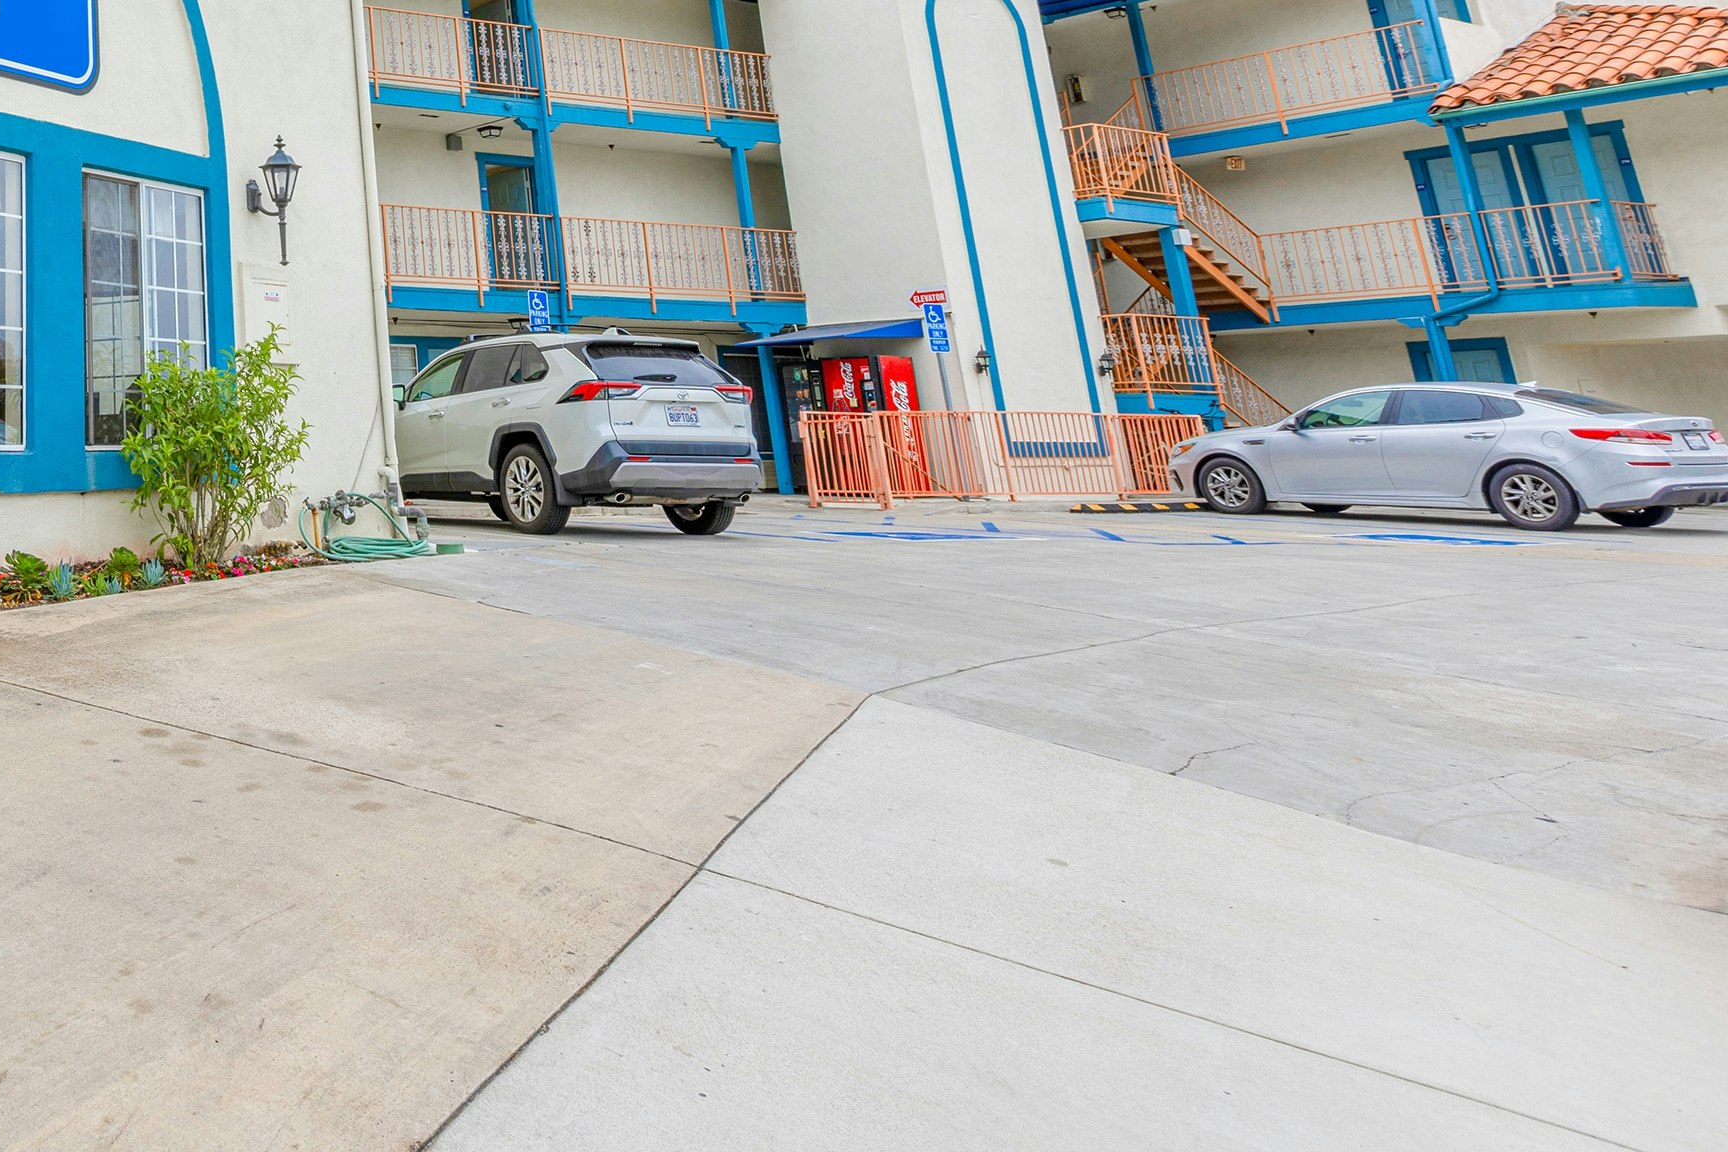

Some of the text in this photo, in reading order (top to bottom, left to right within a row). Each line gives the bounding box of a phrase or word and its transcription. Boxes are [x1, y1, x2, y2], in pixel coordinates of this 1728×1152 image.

[913, 293, 945, 303] ELEVATOR
[529, 310, 549, 318] PARKING
[534, 317, 545, 325] ONLY
[932, 330, 943, 338] ONLY
[839, 361, 855, 400] Coca-Cola
